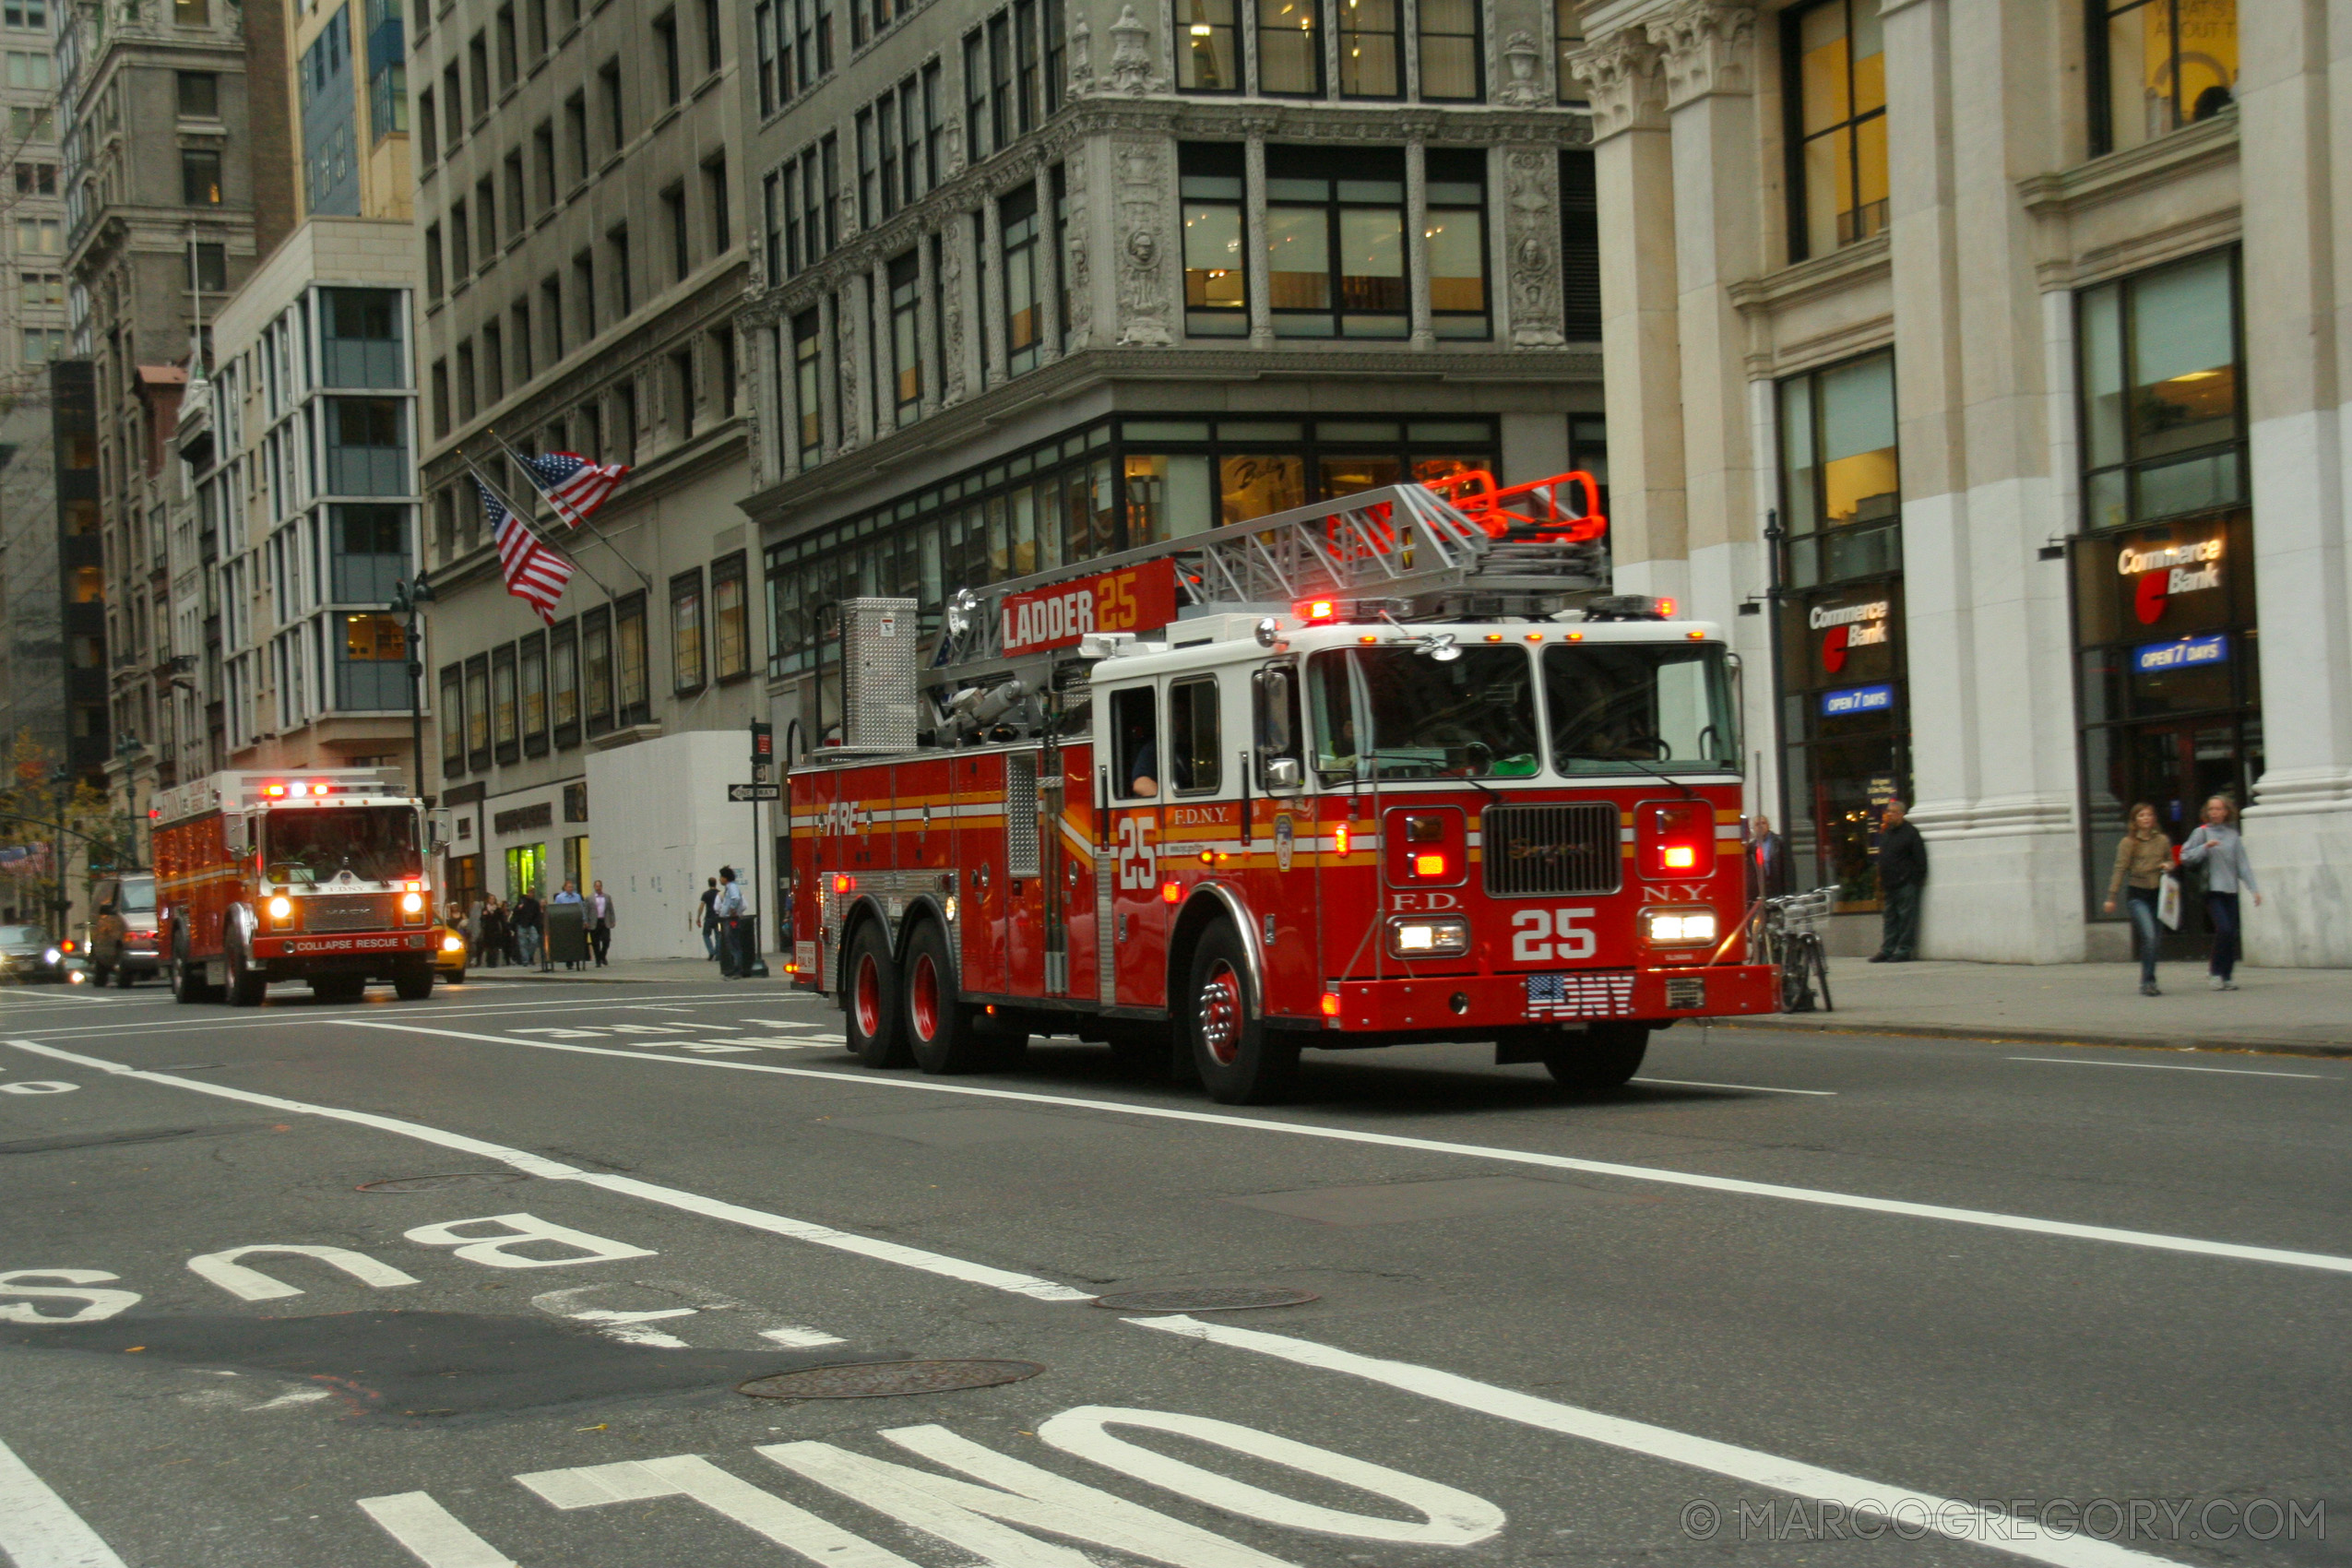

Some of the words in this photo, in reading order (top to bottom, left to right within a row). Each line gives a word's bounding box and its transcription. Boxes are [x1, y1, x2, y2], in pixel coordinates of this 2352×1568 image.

[2118, 540, 2221, 575] Commerce
[2168, 562, 2220, 595] Bank
[1003, 589, 1094, 649] LADDER
[1098, 572, 1137, 632] 25
[1809, 601, 1888, 630] Commerce
[1847, 620, 1887, 647] Bank
[2141, 648, 2174, 668] OPEN
[2174, 644, 2187, 662] 7
[2187, 644, 2219, 661] DAYS
[1828, 696, 1853, 711] OPEN
[1853, 692, 1862, 707] 7
[1862, 692, 1887, 707] DAYS
[826, 801, 860, 837] FIRE
[1173, 807, 1229, 825] F.D.N.Y.
[1119, 816, 1155, 889] 25
[1392, 892, 1464, 911] F.D.
[1640, 884, 1714, 902] N.Y.
[297, 940, 352, 951] COLLAPSE
[356, 938, 398, 948] RESCUE
[1511, 907, 1597, 961] 25
[1527, 972, 1635, 1021] FDNY
[629, 1034, 847, 1053] ANE
[0, 1213, 659, 1324] BUS
